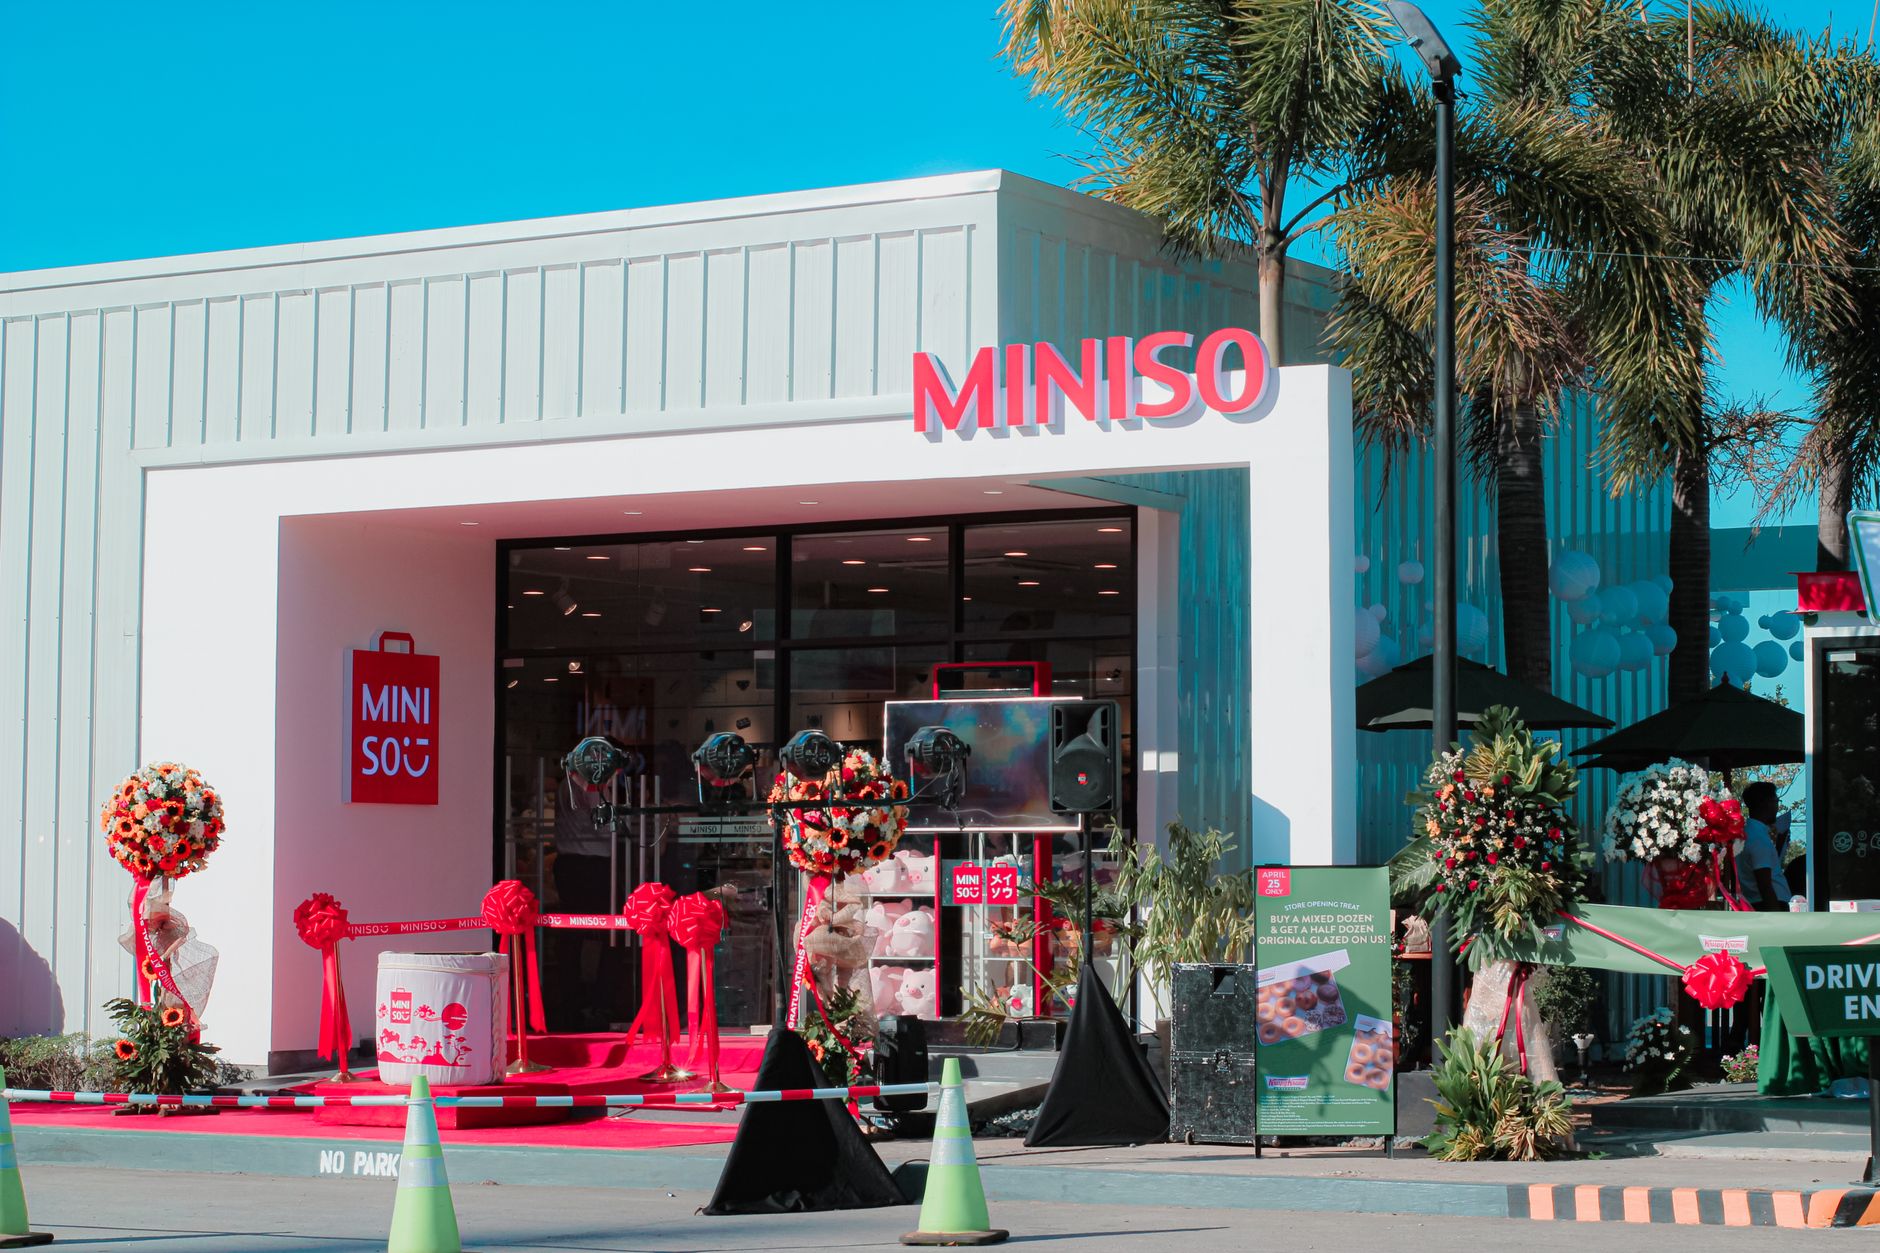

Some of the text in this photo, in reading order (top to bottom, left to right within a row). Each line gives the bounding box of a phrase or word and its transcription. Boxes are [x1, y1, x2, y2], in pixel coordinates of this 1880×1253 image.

[913, 327, 1267, 433] MINISO
[362, 683, 430, 725] MINI
[689, 825, 762, 834] MINISO MINISO
[956, 874, 980, 885] MINI
[990, 873, 1013, 887] メイ
[1262, 871, 1286, 879] APRIL
[1267, 879, 1281, 889] 25
[991, 887, 1013, 899] ソウ
[1284, 900, 1361, 911] STORE OPENING TREAT
[569, 916, 599, 926] MINISO
[1270, 915, 1290, 924] BUY
[1291, 915, 1300, 924] A
[1302, 915, 1334, 923] MIXED
[348, 918, 491, 935] INISO MINISO MINIS
[1270, 925, 1374, 934] & GET A HALF DOZEN
[142, 927, 155, 957] TOTAL
[1258, 935, 1387, 945] ORIGINAL GLAZED ON US!
[391, 1000, 410, 1010] MINI
[1845, 995, 1880, 1020] EN
[320, 1150, 345, 1174] NO
